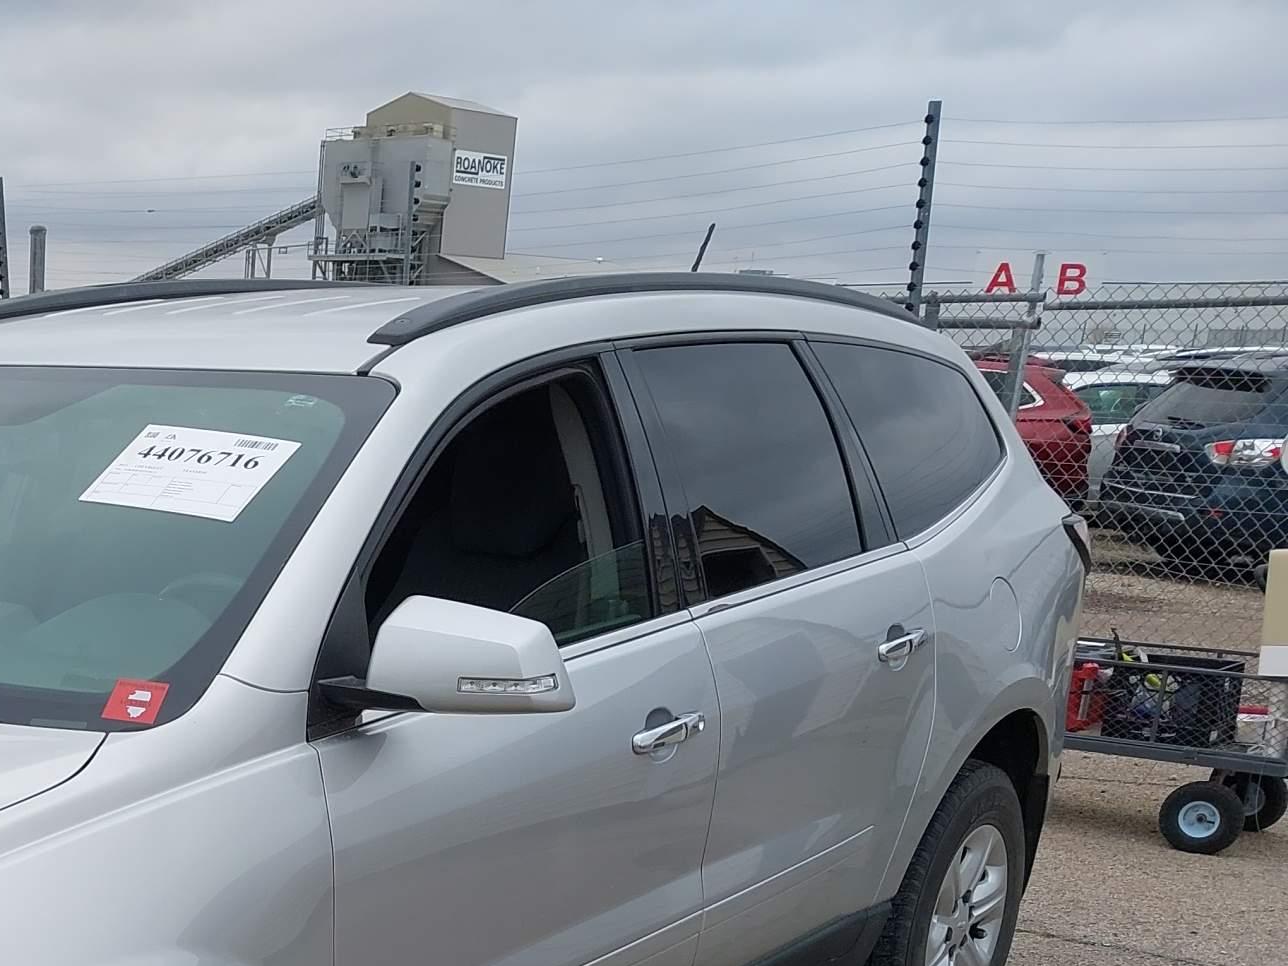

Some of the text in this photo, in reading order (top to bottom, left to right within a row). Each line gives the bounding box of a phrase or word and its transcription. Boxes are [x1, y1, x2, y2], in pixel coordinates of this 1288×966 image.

[455, 156, 505, 175] ROANOKE
[454, 175, 504, 187] CONCRETE PRODUCTS
[985, 262, 1087, 295] A B
[137, 445, 265, 470] 44076716
